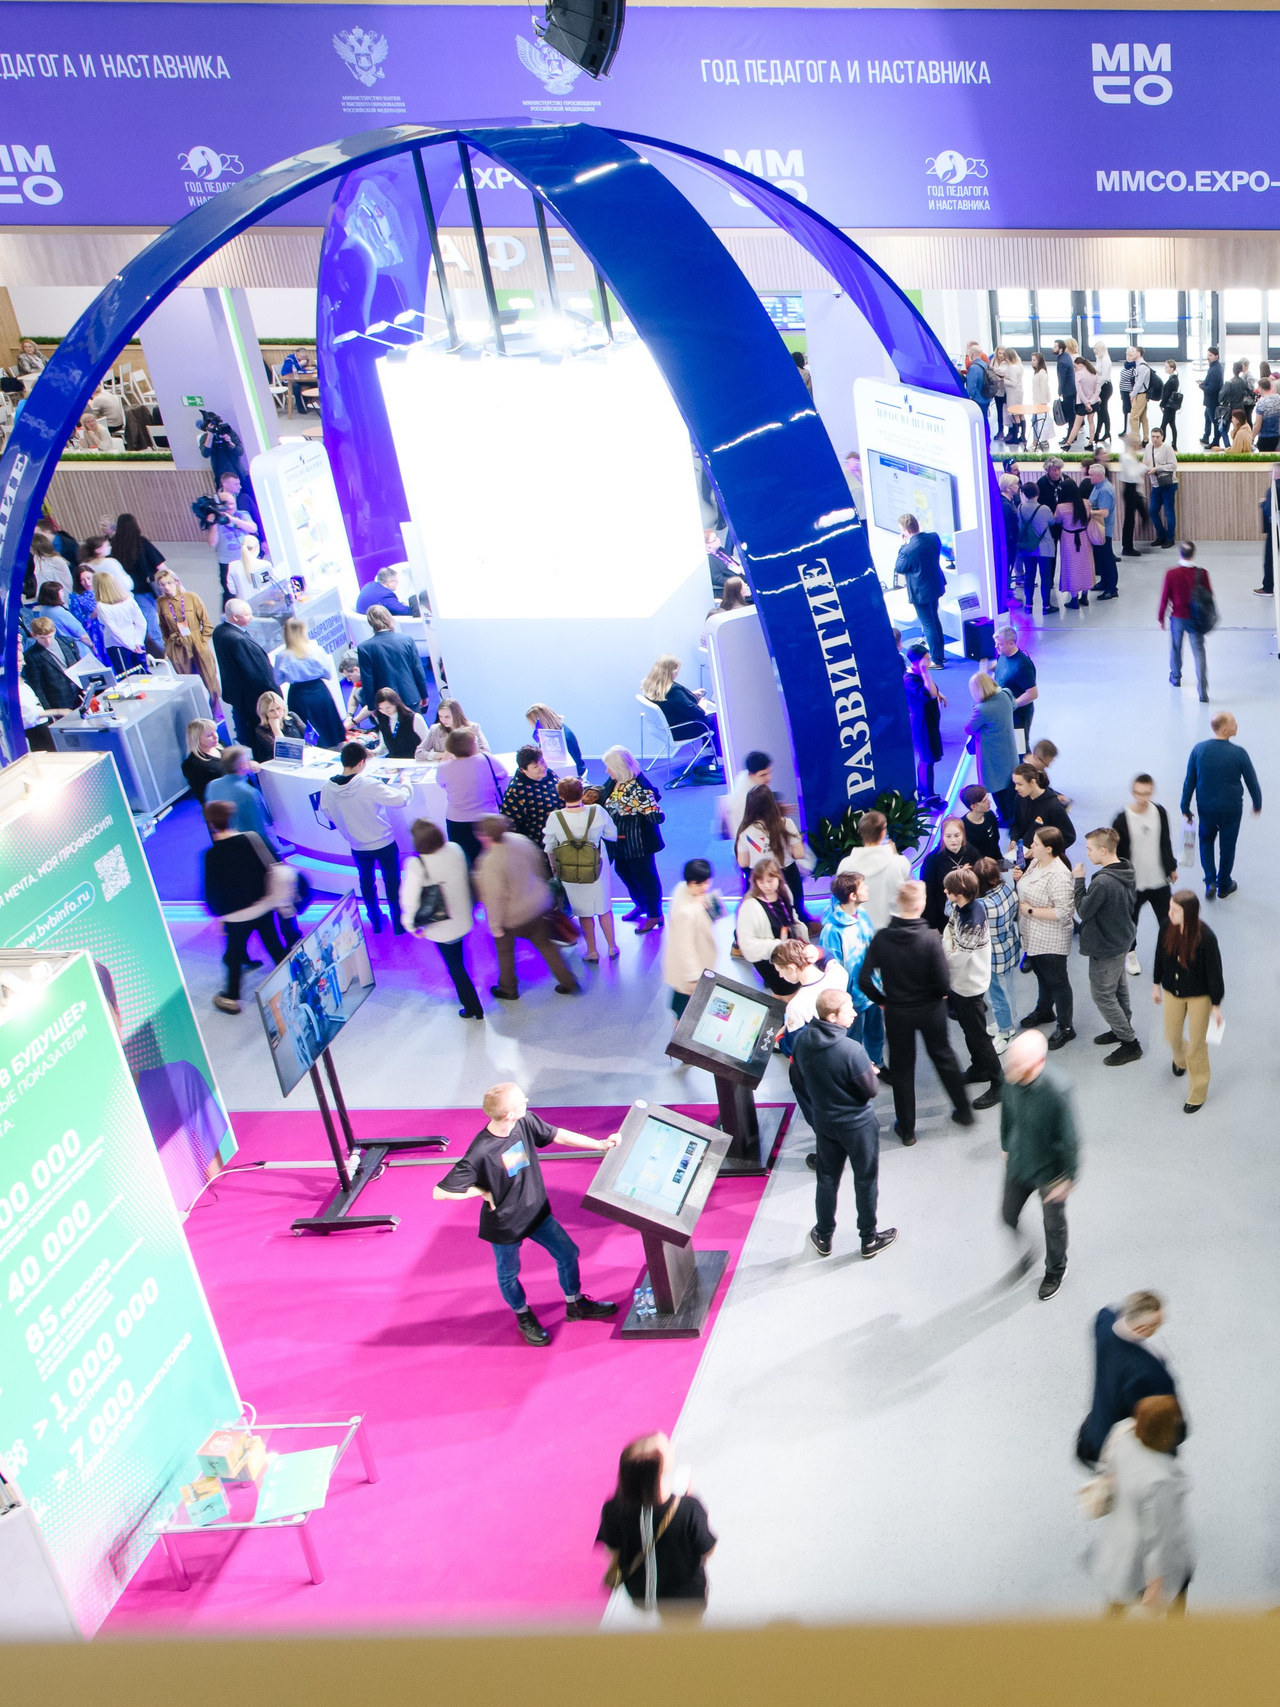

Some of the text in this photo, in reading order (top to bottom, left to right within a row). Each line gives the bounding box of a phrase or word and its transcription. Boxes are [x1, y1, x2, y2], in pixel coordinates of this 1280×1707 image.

[0, 53, 231, 80] ДАГОГА И НАСТАВНИКА
[700, 59, 991, 86] ГОД ПЕДАГОГА И НАСТАВНИКА
[184, 181, 203, 194] ГОД
[187, 195, 197, 207] И
[927, 185, 990, 198] ГОД ПЕДАГОГА
[928, 199, 991, 211] И НАСТАВНИКА
[431, 234, 576, 274] АФЕ
[797, 557, 876, 800] РАЗВИТИЕ
[36, 855, 60, 878] МОЯ
[58, 814, 114, 862] ПРОФЕССИЯ!
[10, 999, 88, 1076] БУДУЩЕЕ»
[17, 1023, 88, 1096] ПОКАЗАТЕЛИ
[31, 1128, 81, 1191] 000
[41, 1199, 91, 1263] 000
[25, 1304, 59, 1354] 85
[49, 1392, 68, 1421] 1
[67, 1332, 114, 1397] 000
[115, 1277, 159, 1338] 000
[88, 1379, 134, 1445] 000
